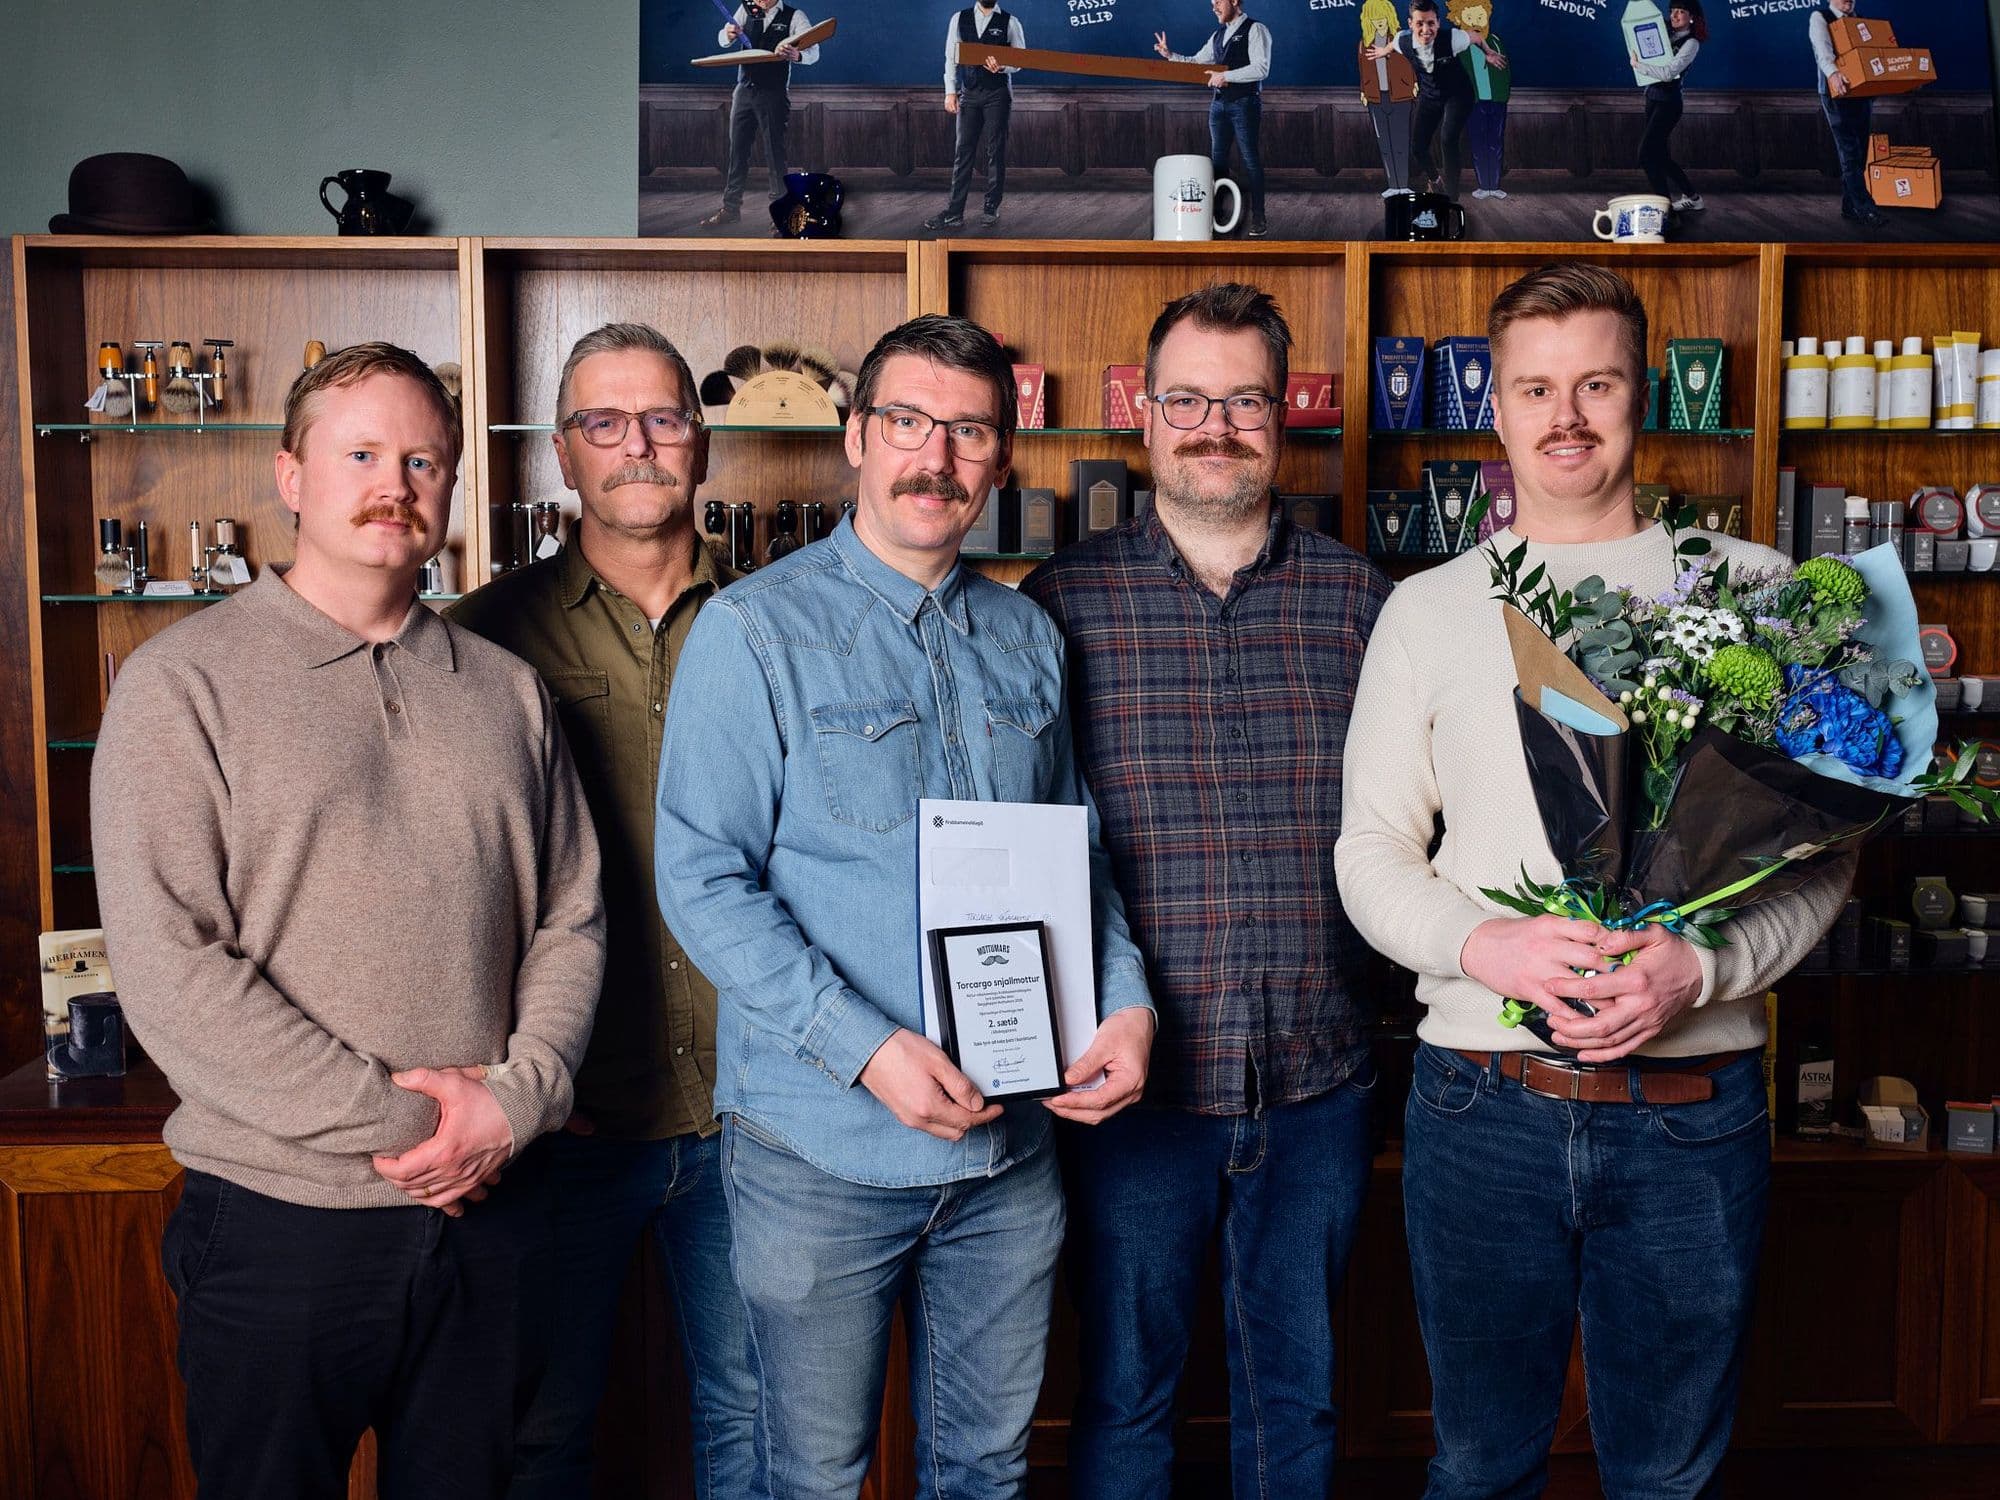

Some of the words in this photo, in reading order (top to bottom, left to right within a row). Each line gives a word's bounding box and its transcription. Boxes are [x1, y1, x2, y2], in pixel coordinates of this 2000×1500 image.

[1070, 11, 1113, 27] BILIÐ
[976, 944, 1010, 955] MOTTUMARS
[49, 951, 107, 963] HERRAMEN
[956, 980, 993, 990] Torcargo
[993, 975, 1040, 988] snjallmottur
[988, 1019, 996, 1028] 2.
[997, 1017, 1018, 1027] sætið
[1800, 1072, 1831, 1082] ASTRA
